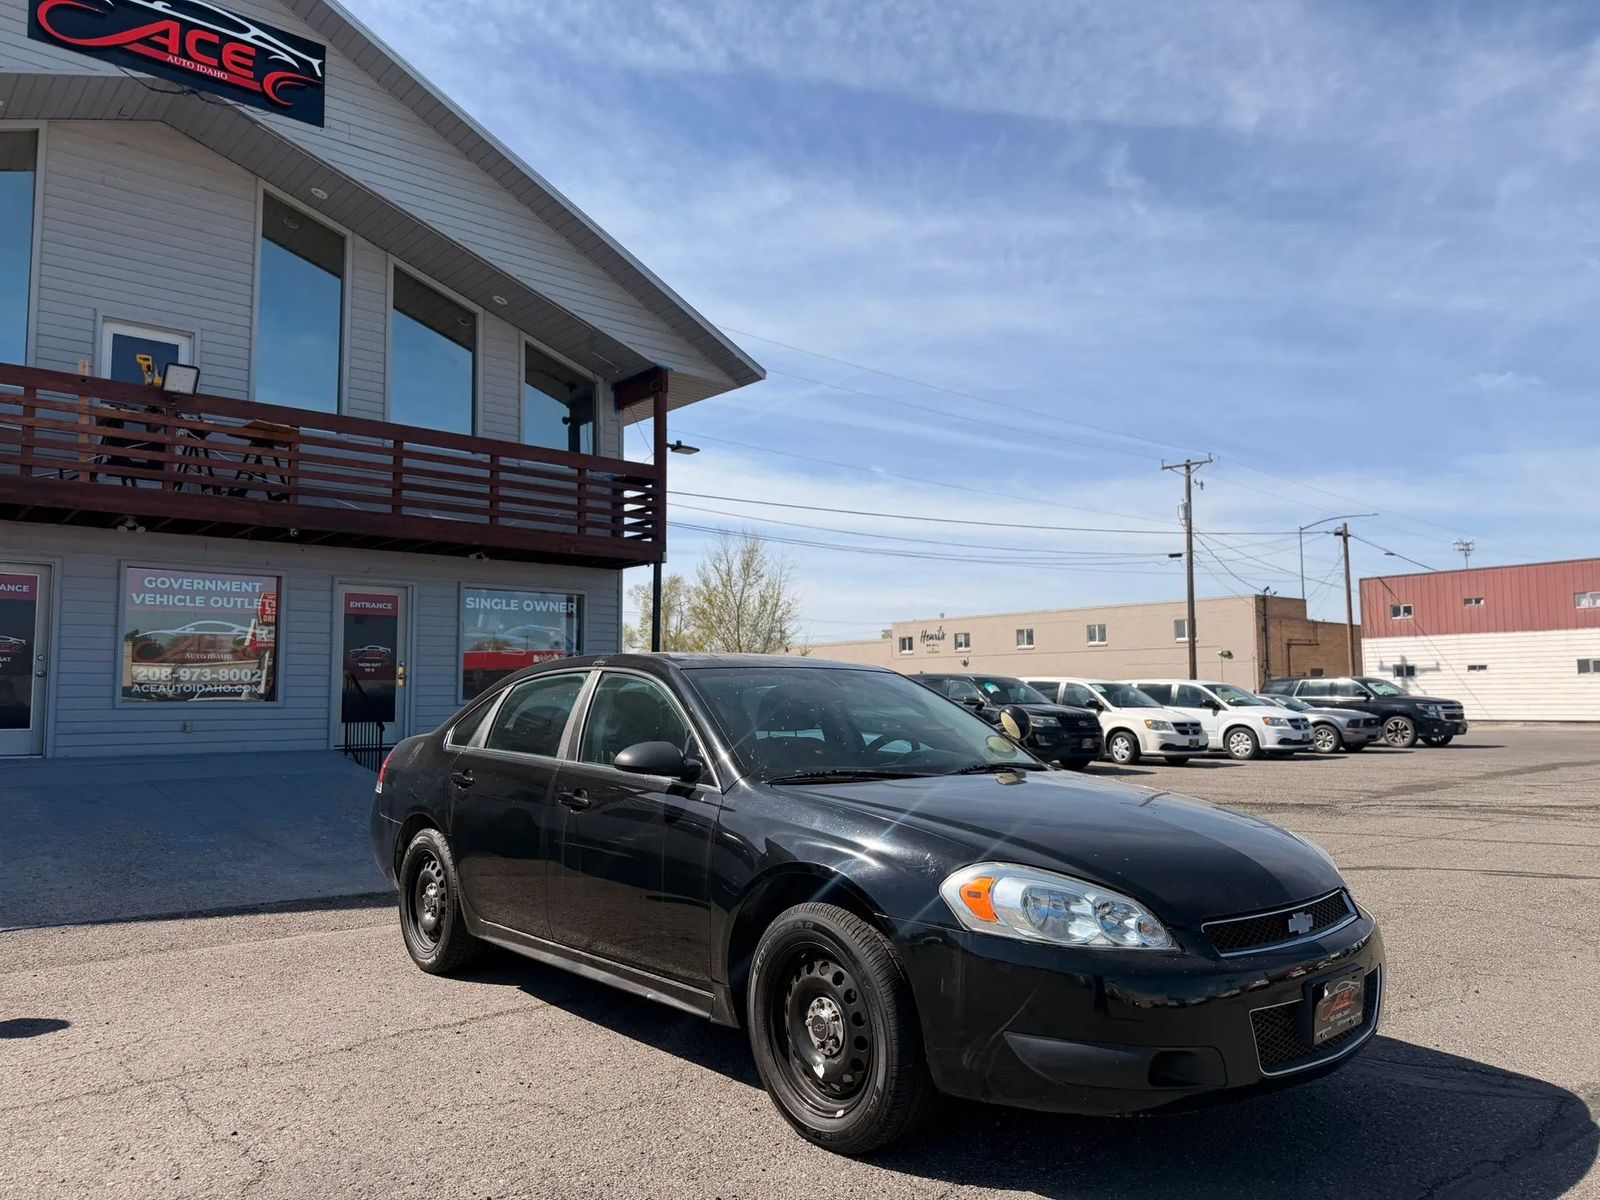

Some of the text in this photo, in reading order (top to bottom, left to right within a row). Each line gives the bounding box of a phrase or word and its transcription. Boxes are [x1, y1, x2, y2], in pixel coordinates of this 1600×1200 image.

[122, 19, 257, 79] ACE
[166, 54, 228, 81] AUTO IDAHO
[0, 583, 30, 593] ANCE
[143, 576, 263, 593] GOVERNMENT
[131, 593, 205, 607] VEHICLE
[210, 596, 272, 610] OUTLET
[349, 601, 392, 610] ENTRANCE
[465, 597, 577, 613] SINGLE OWNER
[135, 667, 262, 682] 208-973-8002
[131, 683, 263, 693] ACEAUTOIDAHO.COM
